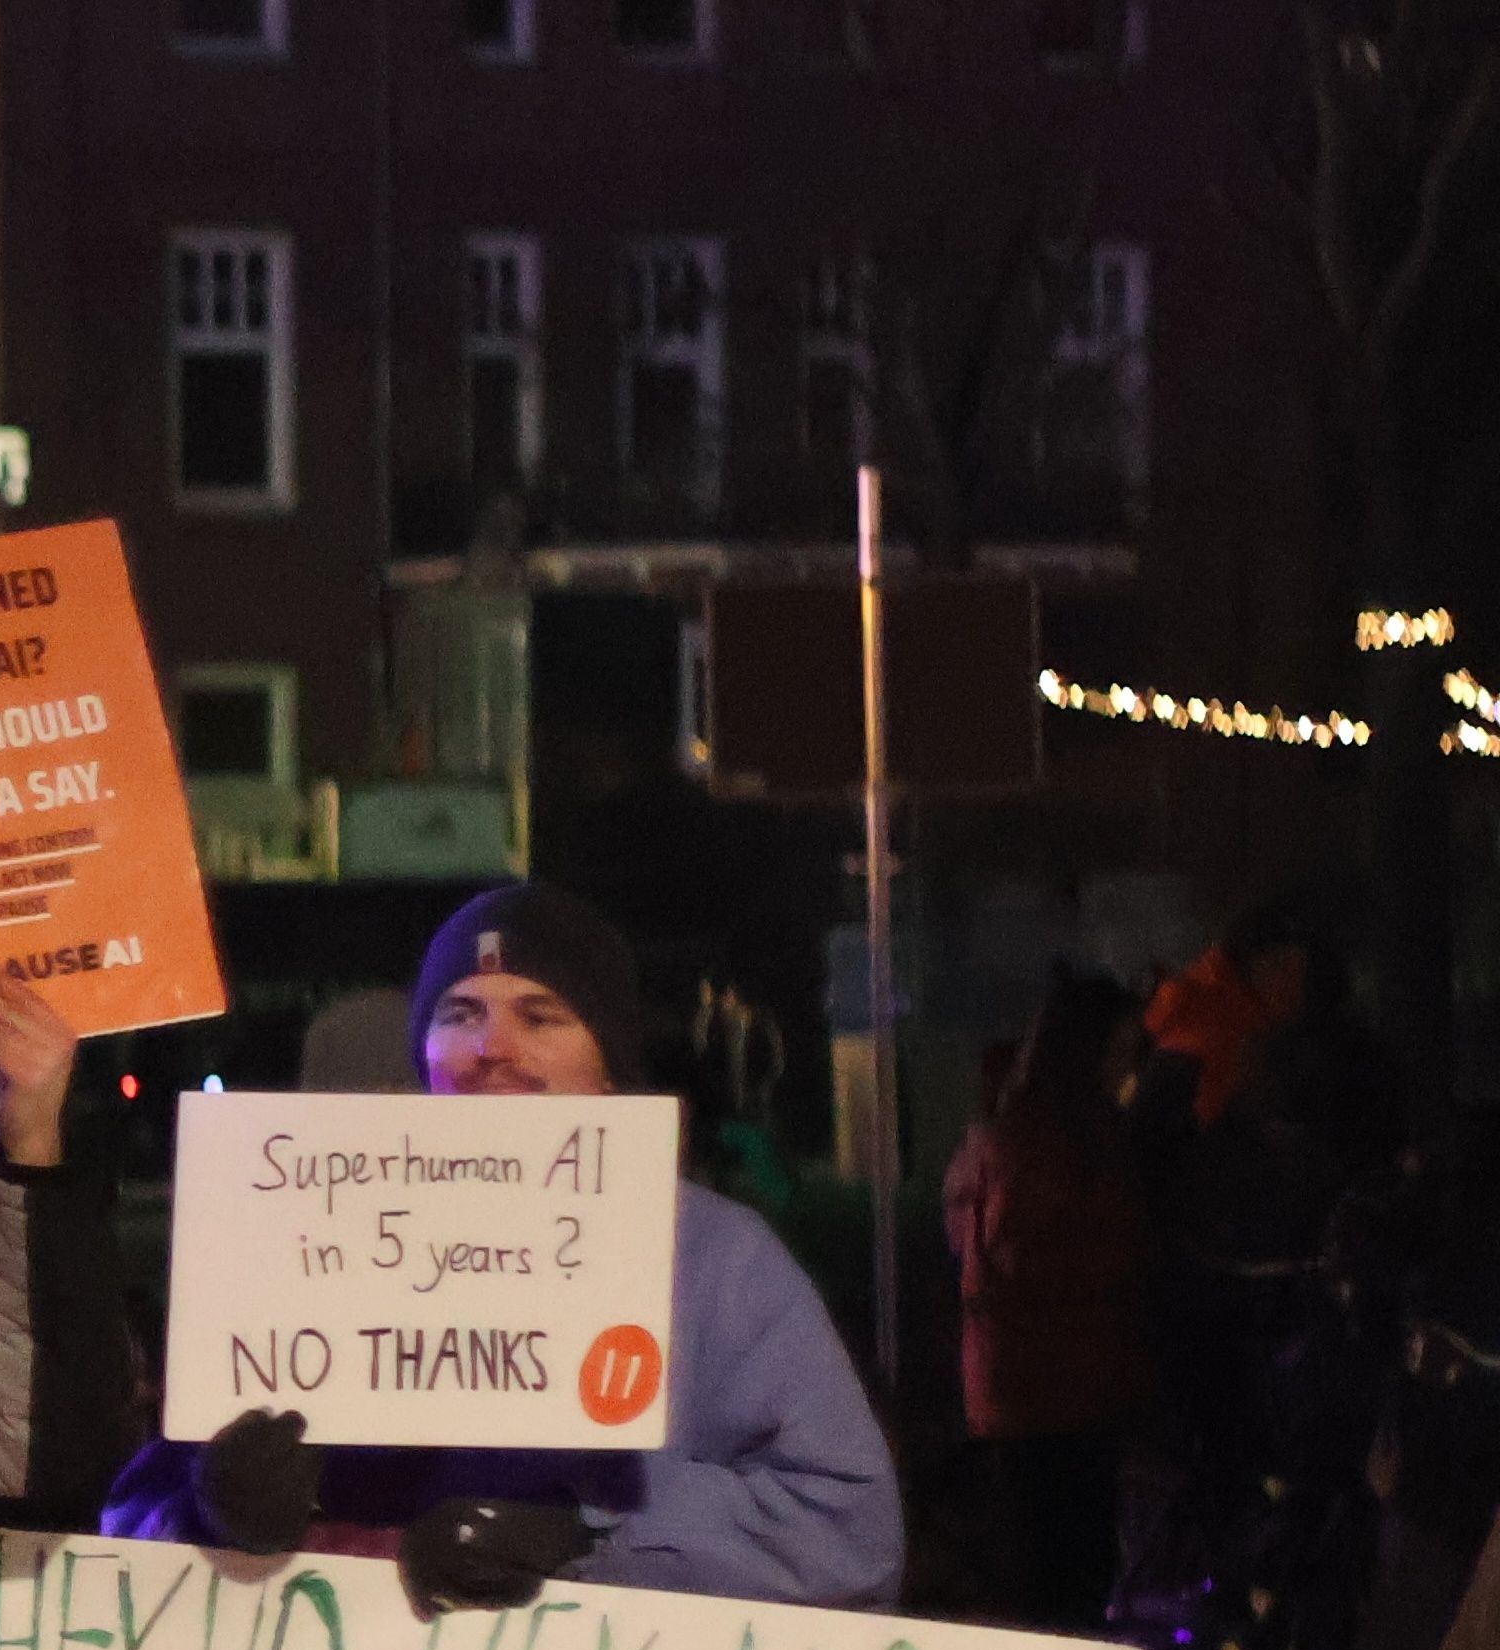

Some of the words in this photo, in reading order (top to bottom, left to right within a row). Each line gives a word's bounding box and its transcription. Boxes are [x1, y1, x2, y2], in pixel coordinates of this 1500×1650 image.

[27, 761, 116, 811] SAY.
[251, 1133, 524, 1215] Superhuman
[543, 1125, 607, 1195] AI
[299, 1233, 343, 1278] in
[371, 1210, 411, 1270] 5
[230, 1327, 333, 1396] NO
[358, 1327, 549, 1393] THANKS
